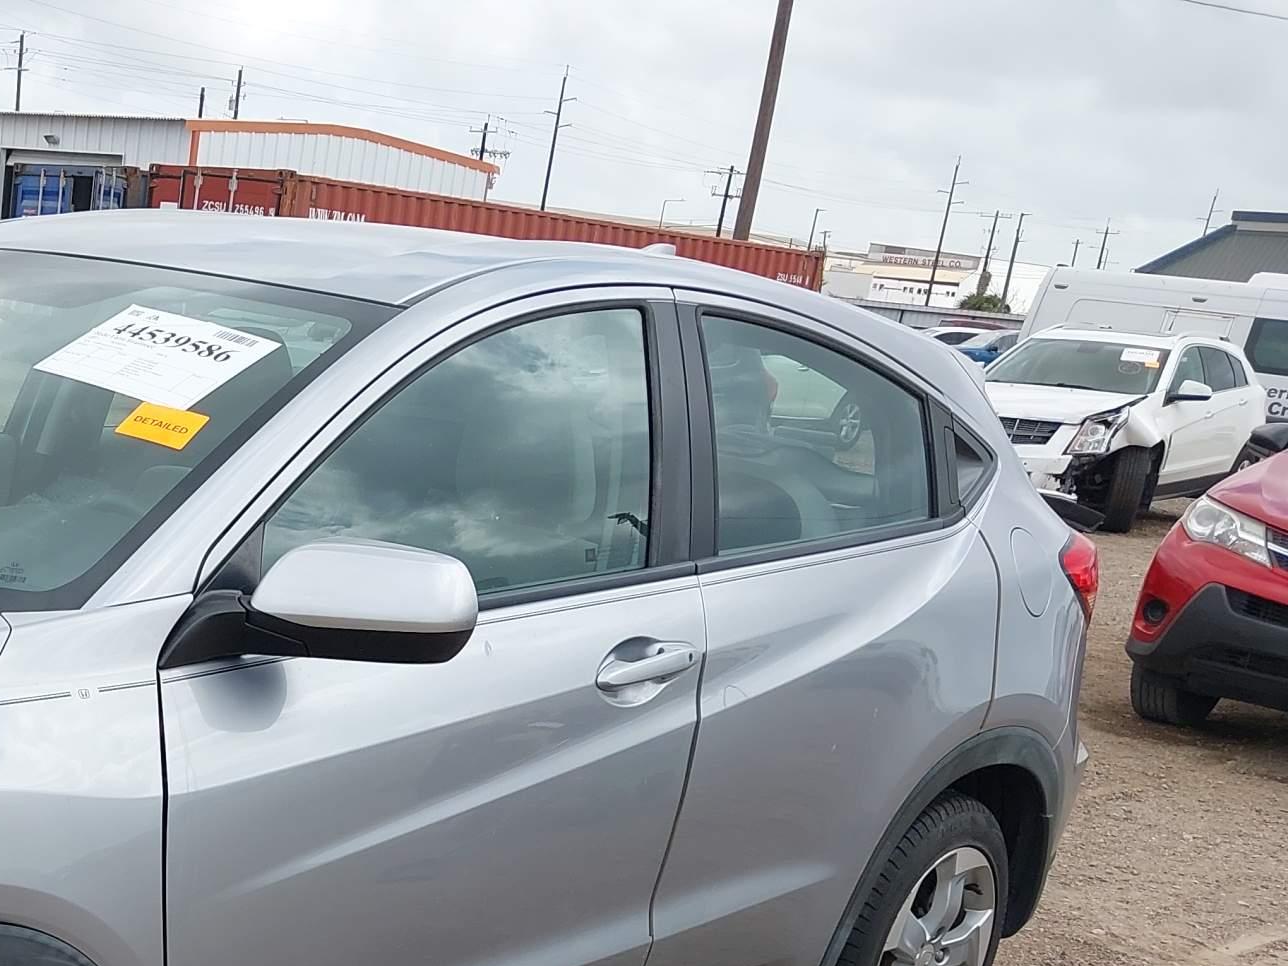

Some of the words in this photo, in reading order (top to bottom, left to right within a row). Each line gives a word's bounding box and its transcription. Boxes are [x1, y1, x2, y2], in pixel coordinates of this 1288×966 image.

[202, 200, 226, 212] ZCSU
[882, 256, 918, 265] WESTERN
[113, 323, 241, 362] 44539586
[133, 415, 189, 434] DETAILED
